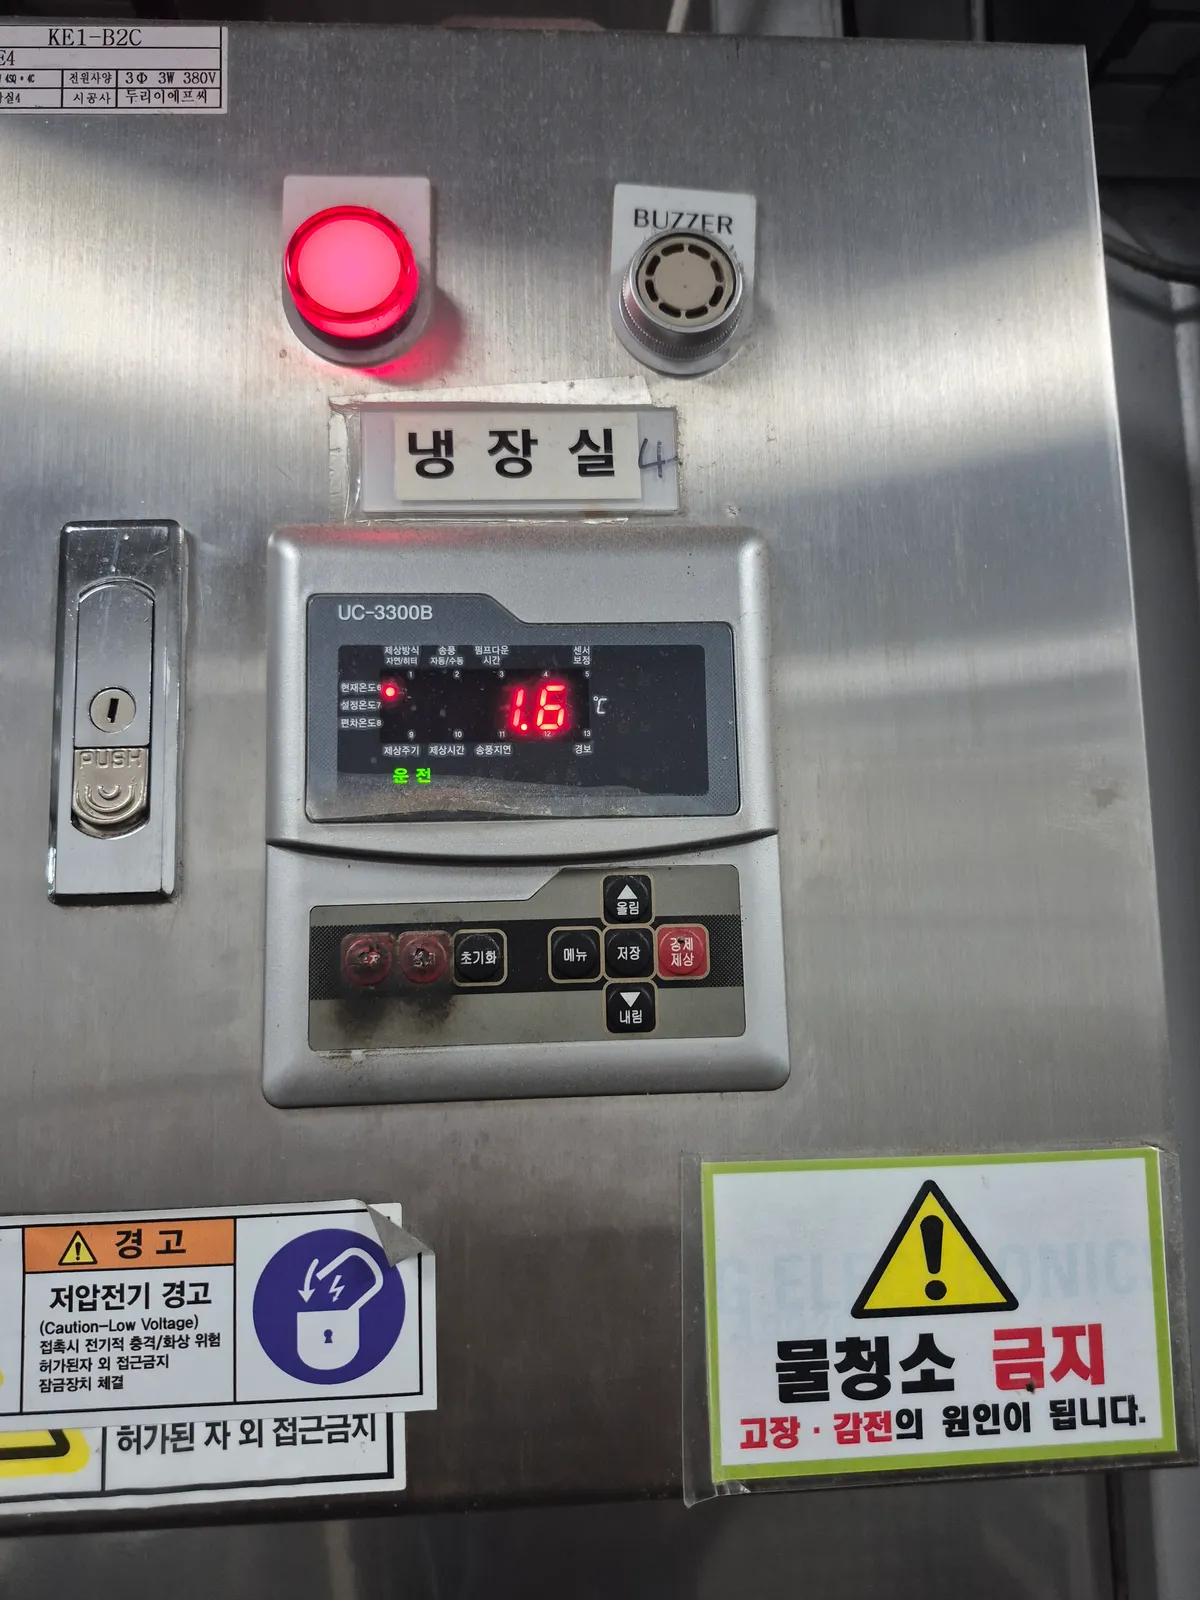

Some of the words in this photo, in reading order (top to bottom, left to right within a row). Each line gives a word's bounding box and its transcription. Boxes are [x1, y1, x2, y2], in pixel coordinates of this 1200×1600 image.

[48, 28, 142, 46] KE1-B2C
[69, 72, 112, 85] 전원사양
[158, 72, 175, 84] 3W
[183, 72, 216, 84] 380V
[0, 91, 20, 104] 실4
[73, 92, 111, 104] 시공사
[125, 89, 207, 104] 두리이에프씨
[634, 208, 733, 235] BUZZER
[638, 437, 679, 479] 4
[338, 604, 434, 621] UC-3300B
[384, 645, 420, 656] 제상방식
[438, 645, 456, 656] 송풍
[474, 645, 509, 657] 펌프다운
[573, 646, 591, 656] 센서
[430, 656, 464, 666] 자동/수동
[483, 656, 501, 666] 시간
[573, 657, 591, 666] 보정
[512, 684, 566, 731] 1.6
[384, 745, 420, 756] 제상주기
[429, 745, 465, 756] 제상시간
[475, 745, 511, 756] 송풍지연
[575, 744, 592, 755] 경보
[79, 750, 145, 769] PUSH
[616, 901, 640, 916] 올림
[460, 950, 497, 965] 초기화
[563, 948, 588, 962] 메뉴
[617, 946, 641, 961] 저장
[671, 953, 695, 967] 제상
[619, 1009, 643, 1024] 내림
[49, 1282, 150, 1312] 저압전기
[162, 1280, 212, 1309] 경고
[141, 1314, 199, 1333] Voltage)
[39, 1338, 80, 1354] 접촉시
[85, 1337, 125, 1353] 전기적
[129, 1334, 190, 1351] 충격/화상
[195, 1332, 221, 1348] 위험
[39, 1358, 93, 1374] 허가된자
[98, 1356, 111, 1371] 외
[116, 1354, 170, 1370] 접근금지
[775, 1333, 956, 1404] 물청소
[992, 1323, 1105, 1391] 금지
[39, 1376, 92, 1393] 잠금장치
[97, 1374, 124, 1390] 체결
[833, 1408, 924, 1445] 감전의
[942, 1401, 1031, 1438] 원인이
[1049, 1394, 1146, 1431] 됩니다.
[117, 1421, 195, 1455] 허가된
[204, 1420, 231, 1450] 자
[239, 1418, 263, 1448] 외
[272, 1413, 376, 1446] 접근금지
